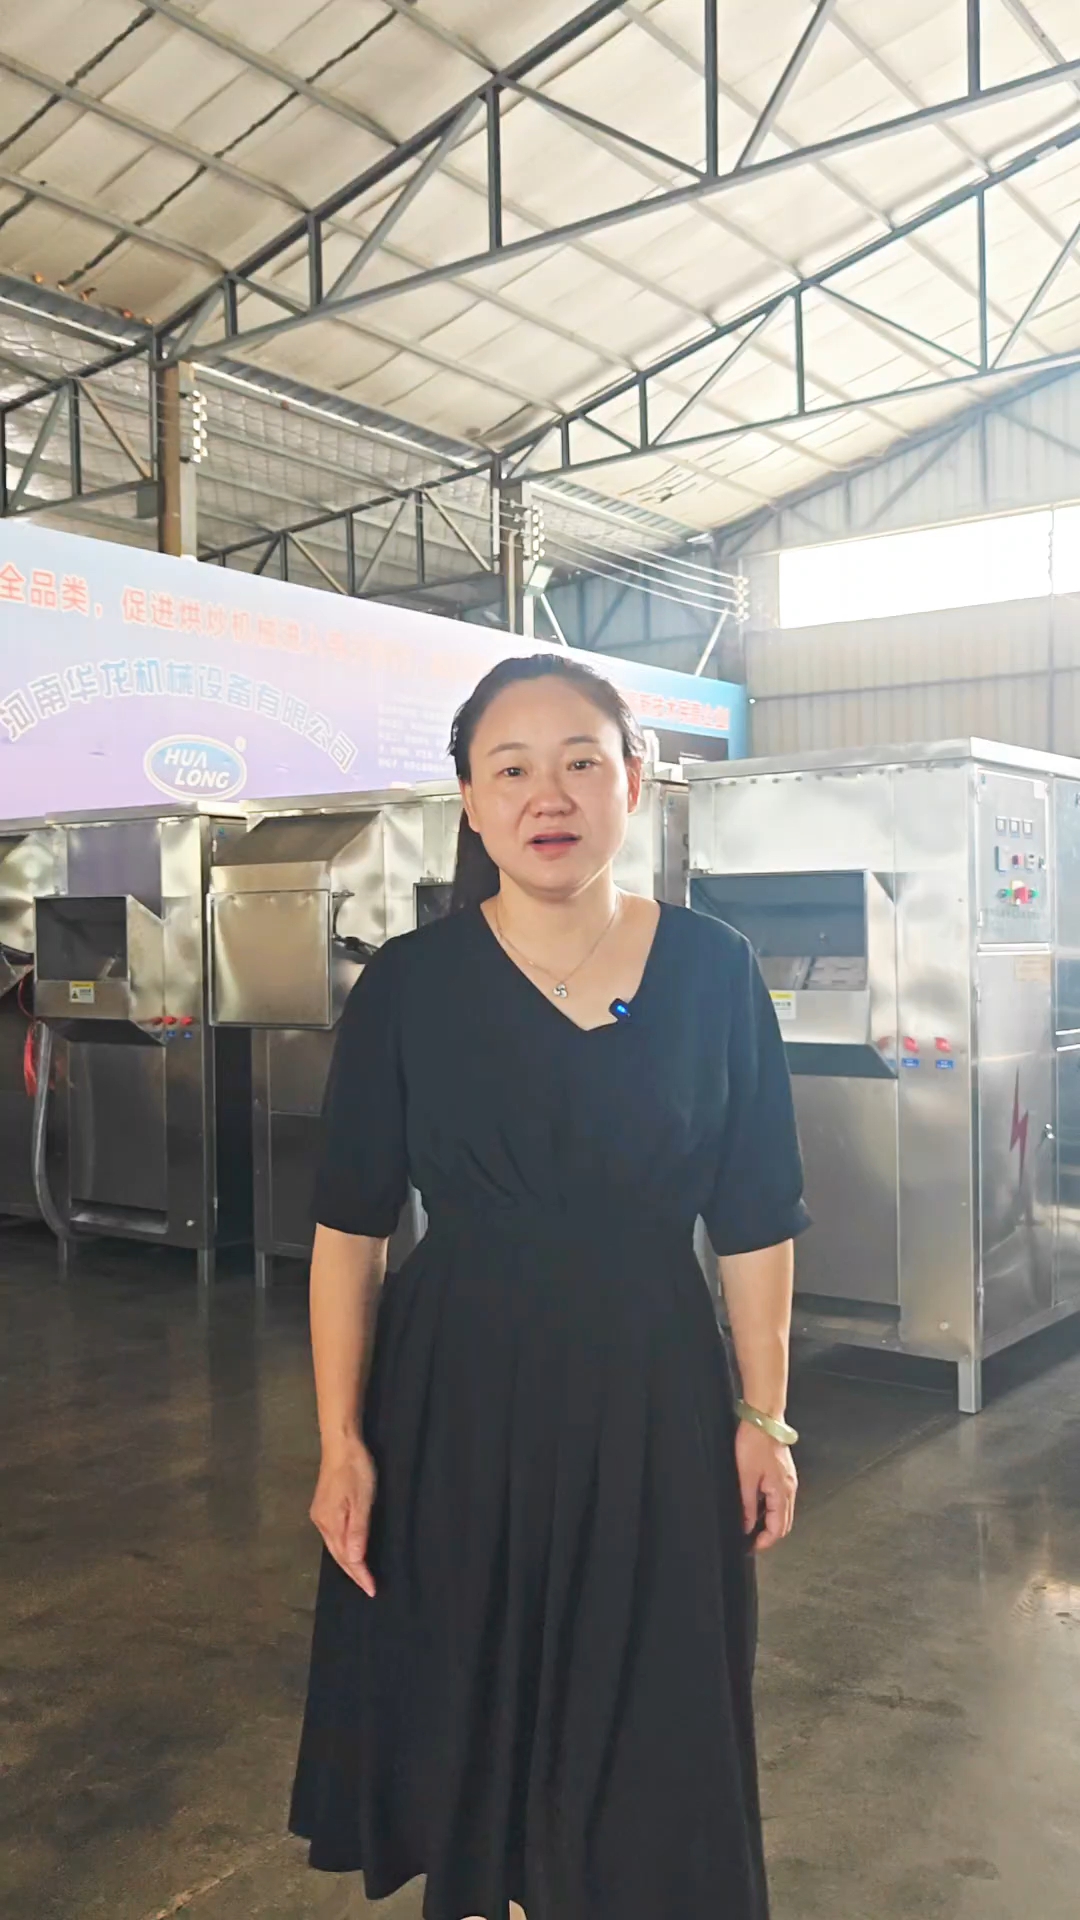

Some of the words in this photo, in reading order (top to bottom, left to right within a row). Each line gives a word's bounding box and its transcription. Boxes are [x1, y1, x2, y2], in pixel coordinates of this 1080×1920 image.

[0, 659, 358, 773] 河南华龙机械设备有限公司
[163, 747, 208, 769] HUA
[174, 767, 230, 789] LONG
